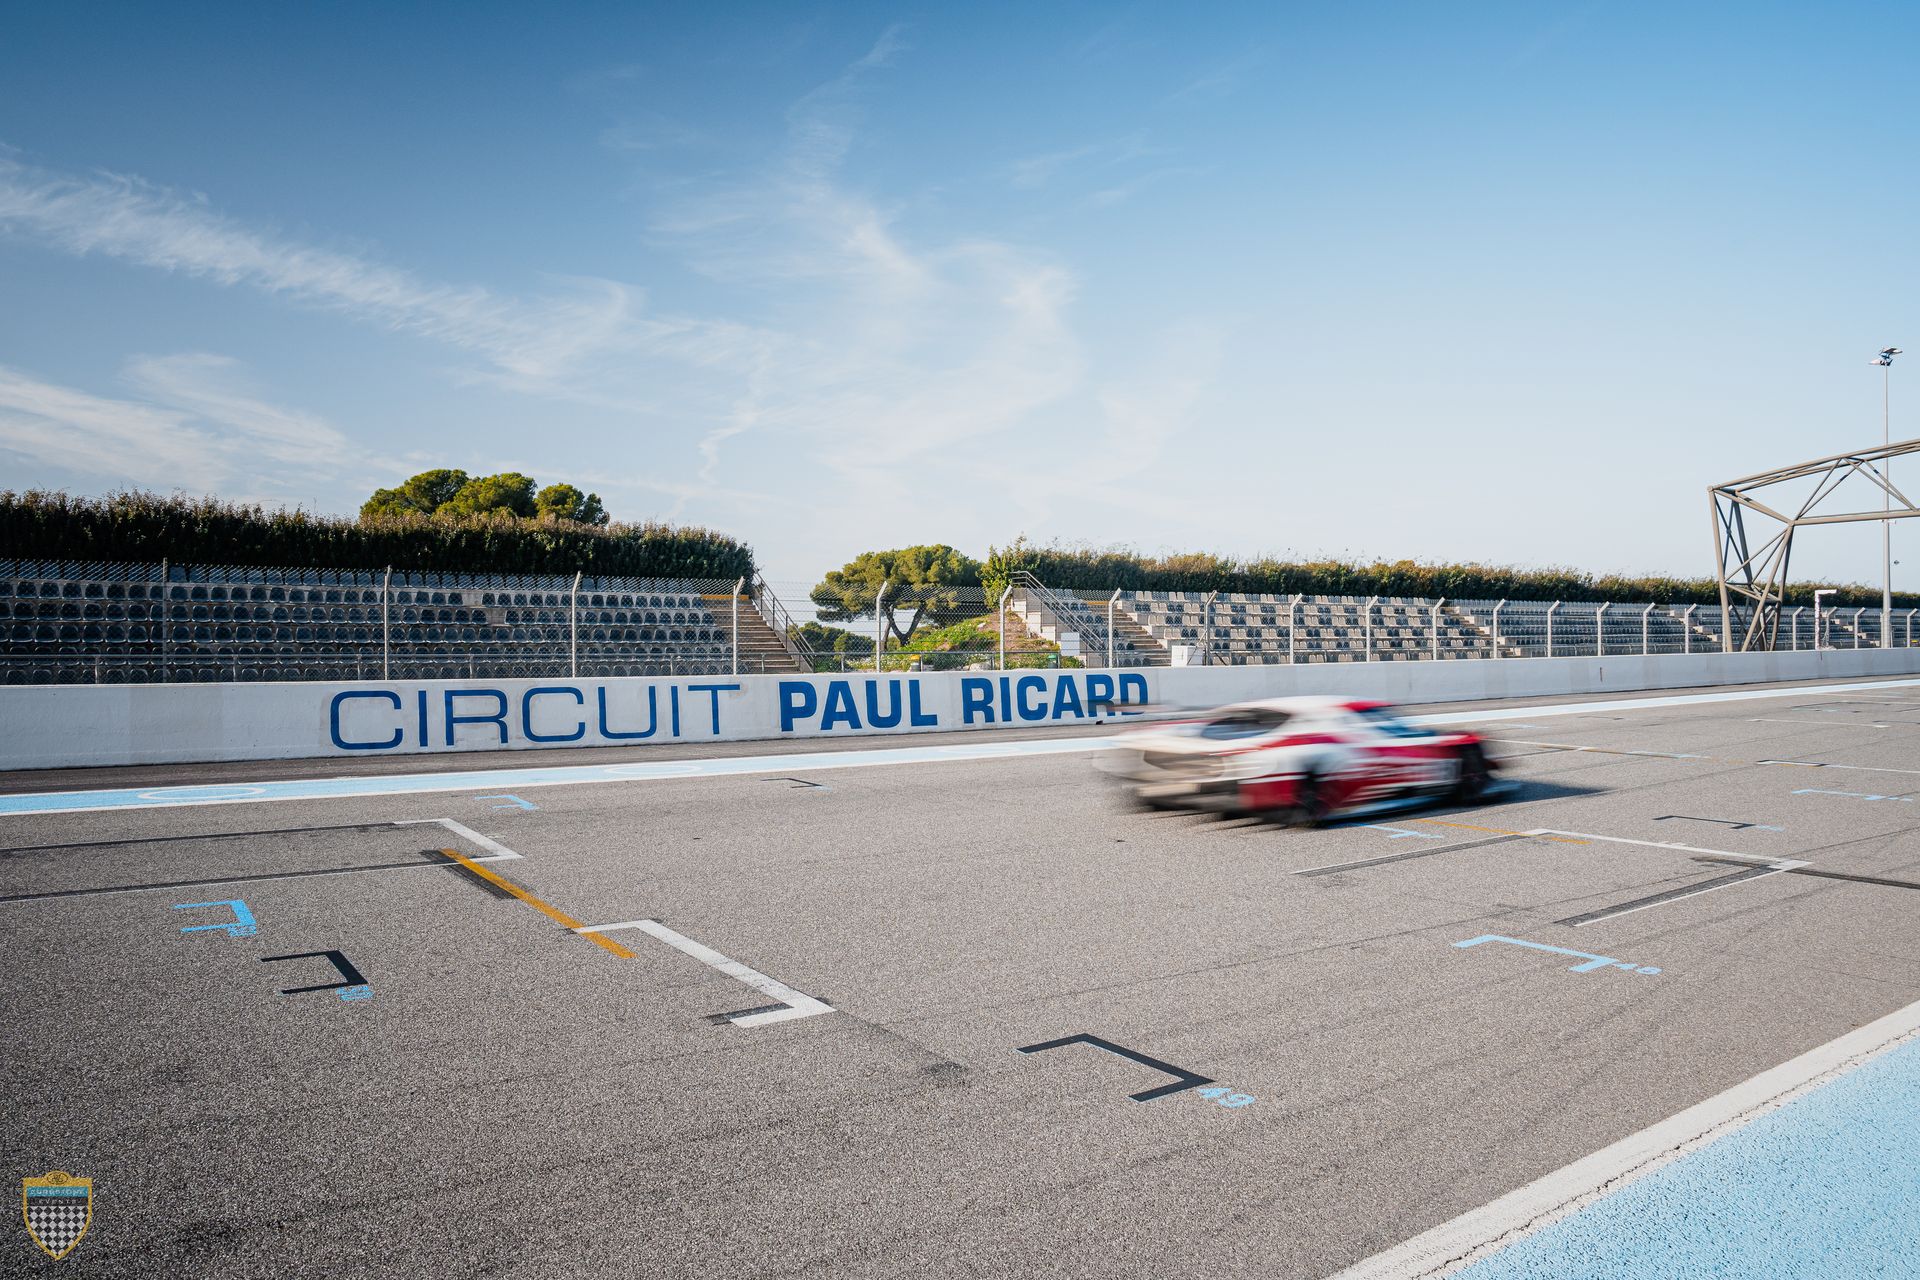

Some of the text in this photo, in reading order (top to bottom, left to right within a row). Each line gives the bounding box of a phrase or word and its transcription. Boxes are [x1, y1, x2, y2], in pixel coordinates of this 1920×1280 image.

[330, 673, 1149, 750] CIRCUIT PAUL RICARD
